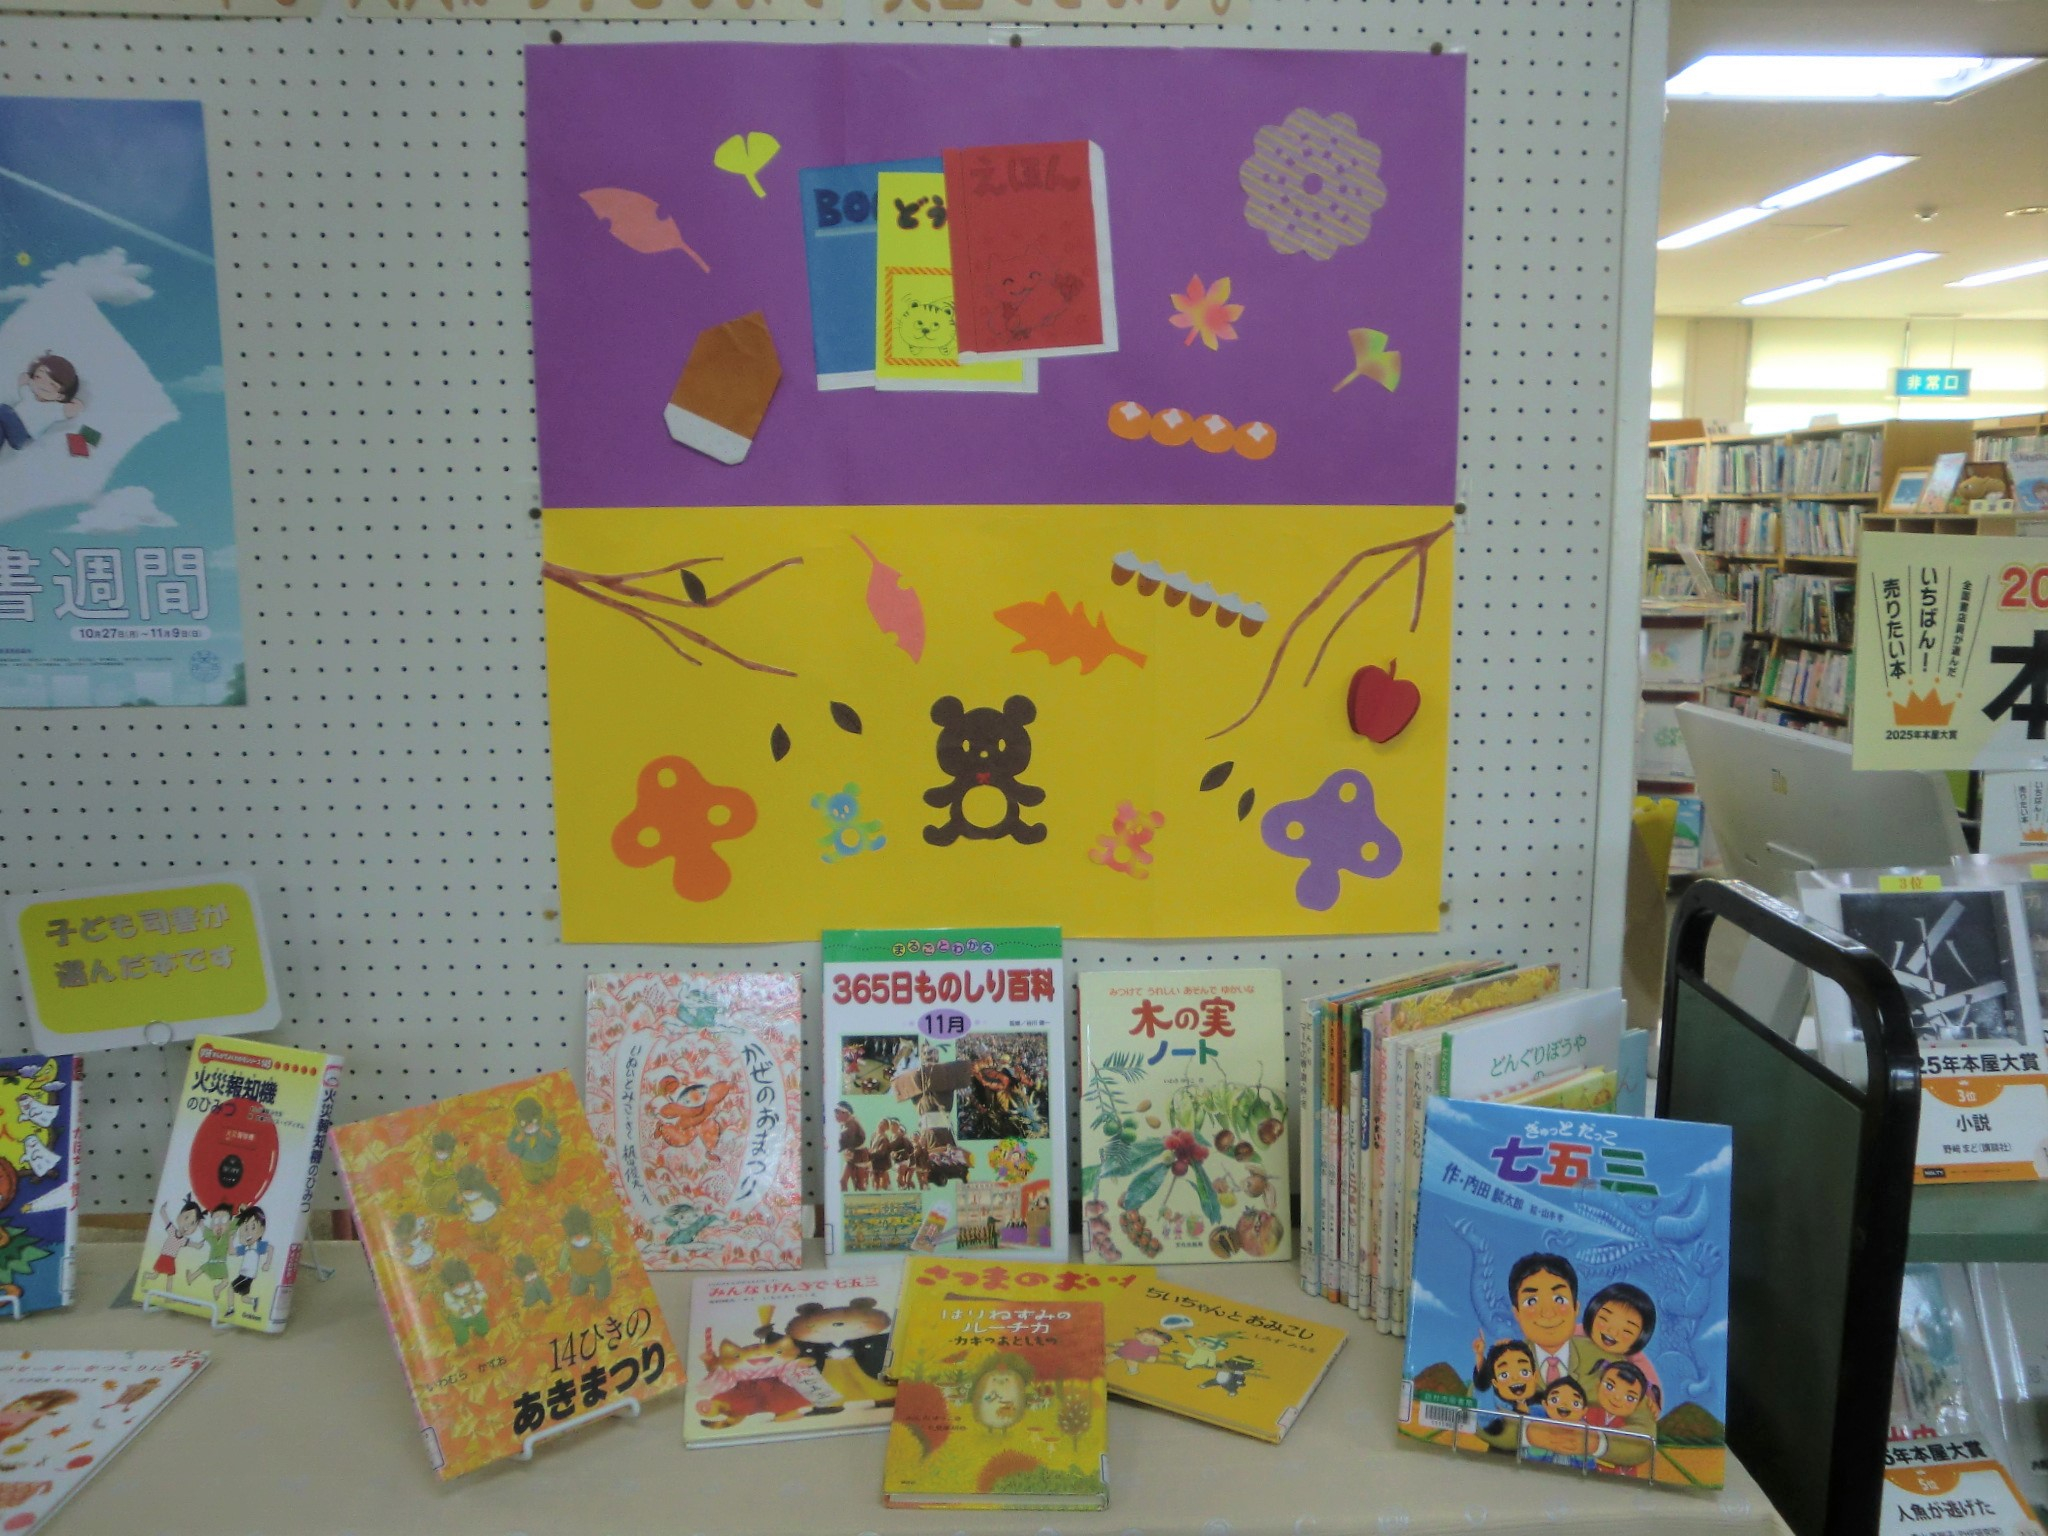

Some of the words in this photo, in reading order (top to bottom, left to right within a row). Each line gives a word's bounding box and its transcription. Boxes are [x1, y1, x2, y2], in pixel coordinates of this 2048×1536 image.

[971, 155, 1082, 197] えほん
[813, 188, 878, 228] BO
[1906, 374, 1960, 391] 非常口
[1882, 577, 1907, 680] 売りたい本
[1885, 729, 1958, 741] 2025年本屋大賞
[45, 903, 230, 948] 子ども司書が
[55, 944, 235, 989] 選んだ本です
[892, 938, 994, 957] まるごとわかる
[832, 967, 1055, 1005] 365日ものしり百科
[925, 1013, 965, 1035] 11月
[1128, 995, 1237, 1039] 木の実
[1147, 1038, 1219, 1066] ノート
[1490, 1034, 1588, 1077] どんぐりぼうや
[191, 1068, 279, 1105] 火災報知機
[186, 1097, 236, 1117] のひみつ
[735, 1042, 781, 1202] かぜのおまつり
[1956, 1114, 1992, 1132] 小説
[1490, 1136, 1660, 1198] 七五三
[708, 1284, 759, 1298] みんな
[833, 1275, 880, 1289] 七五三
[941, 1309, 1072, 1321] はりねずみの
[962, 1321, 1050, 1334] ルーチカ
[1145, 1286, 1243, 1323] ちいちゃんと
[1245, 1314, 1315, 1340] おみこし
[548, 1307, 653, 1374] 14ひきの
[512, 1342, 667, 1436] あきまつり
[1896, 1497, 1997, 1523] 人魚が逃げた
